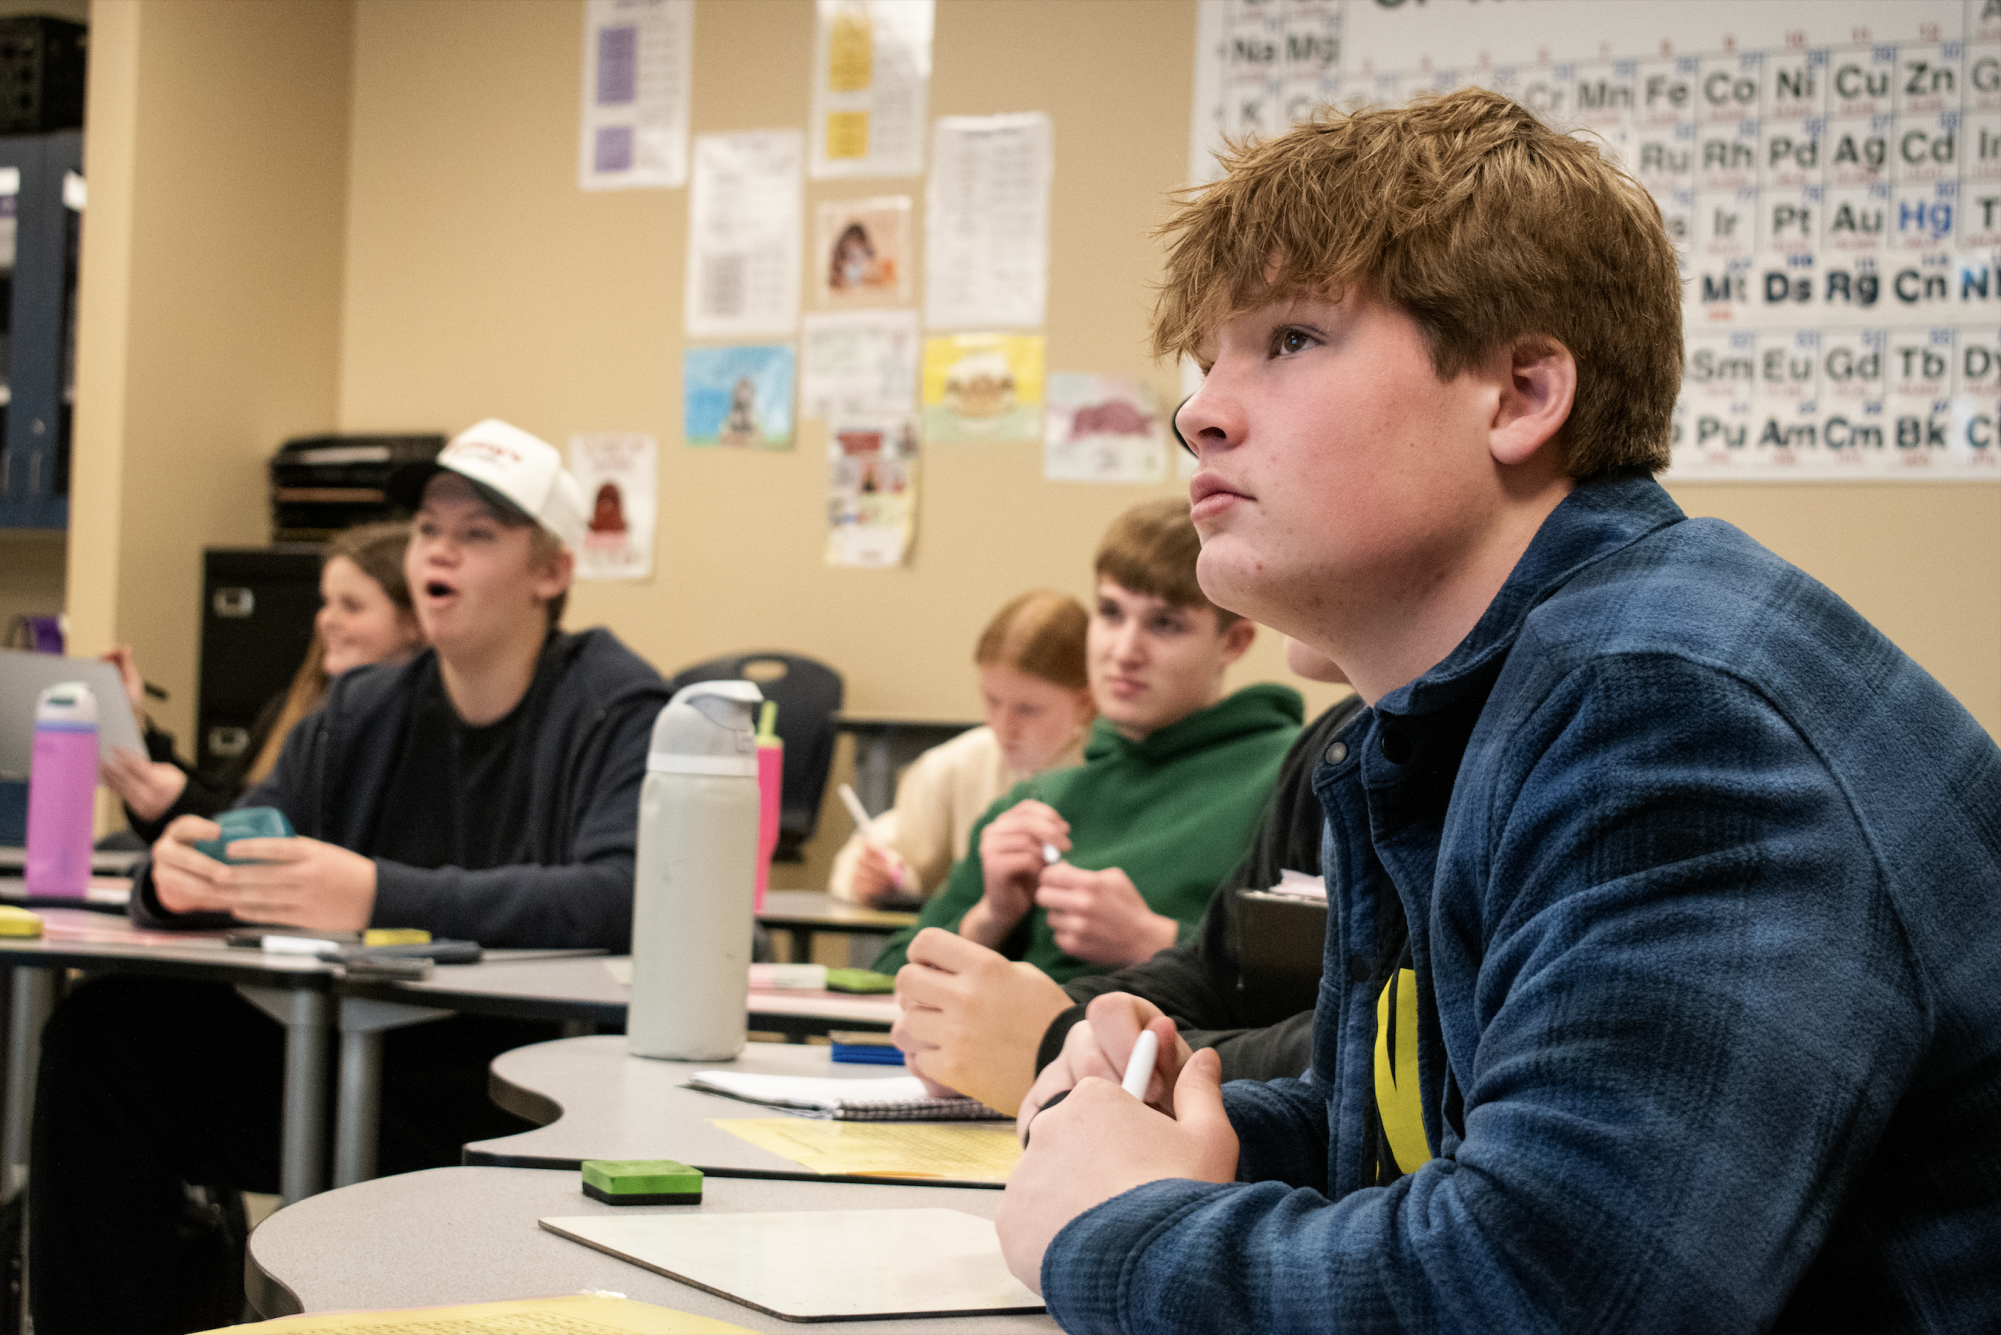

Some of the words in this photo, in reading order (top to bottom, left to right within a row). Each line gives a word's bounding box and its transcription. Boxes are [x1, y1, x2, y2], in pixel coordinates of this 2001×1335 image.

[1578, 79, 1633, 109] Mn
[1645, 73, 1689, 107] Fe
[1704, 71, 1757, 106] Co
[1777, 64, 1814, 99] Ni
[1834, 61, 1889, 98] Cu
[1904, 60, 1955, 96] Zn
[1970, 58, 2001, 92] G
[1639, 141, 1690, 174] Ru
[1703, 137, 1755, 170] Rh
[1769, 134, 1818, 169] Pd
[1833, 133, 1887, 172] Ag
[1901, 129, 1955, 165] Cd
[1713, 205, 1738, 238] Ir
[1772, 204, 1811, 236] Pt
[1831, 203, 1884, 234] Au
[1899, 201, 1953, 240] Hg
[1975, 199, 2001, 231] T
[1701, 273, 1747, 304] Mt
[1764, 271, 1812, 304] Ds
[1825, 269, 1880, 308] Rg
[1893, 269, 1948, 304] Cn
[1693, 348, 1753, 382] Sm
[1763, 347, 1812, 382] Eu
[1825, 347, 1881, 382] Gd
[1898, 346, 1946, 380] Tb
[1697, 416, 1747, 449] Pu
[1758, 418, 1816, 448] Am
[1824, 417, 1883, 449] Cm
[1896, 414, 1946, 449] Bk
